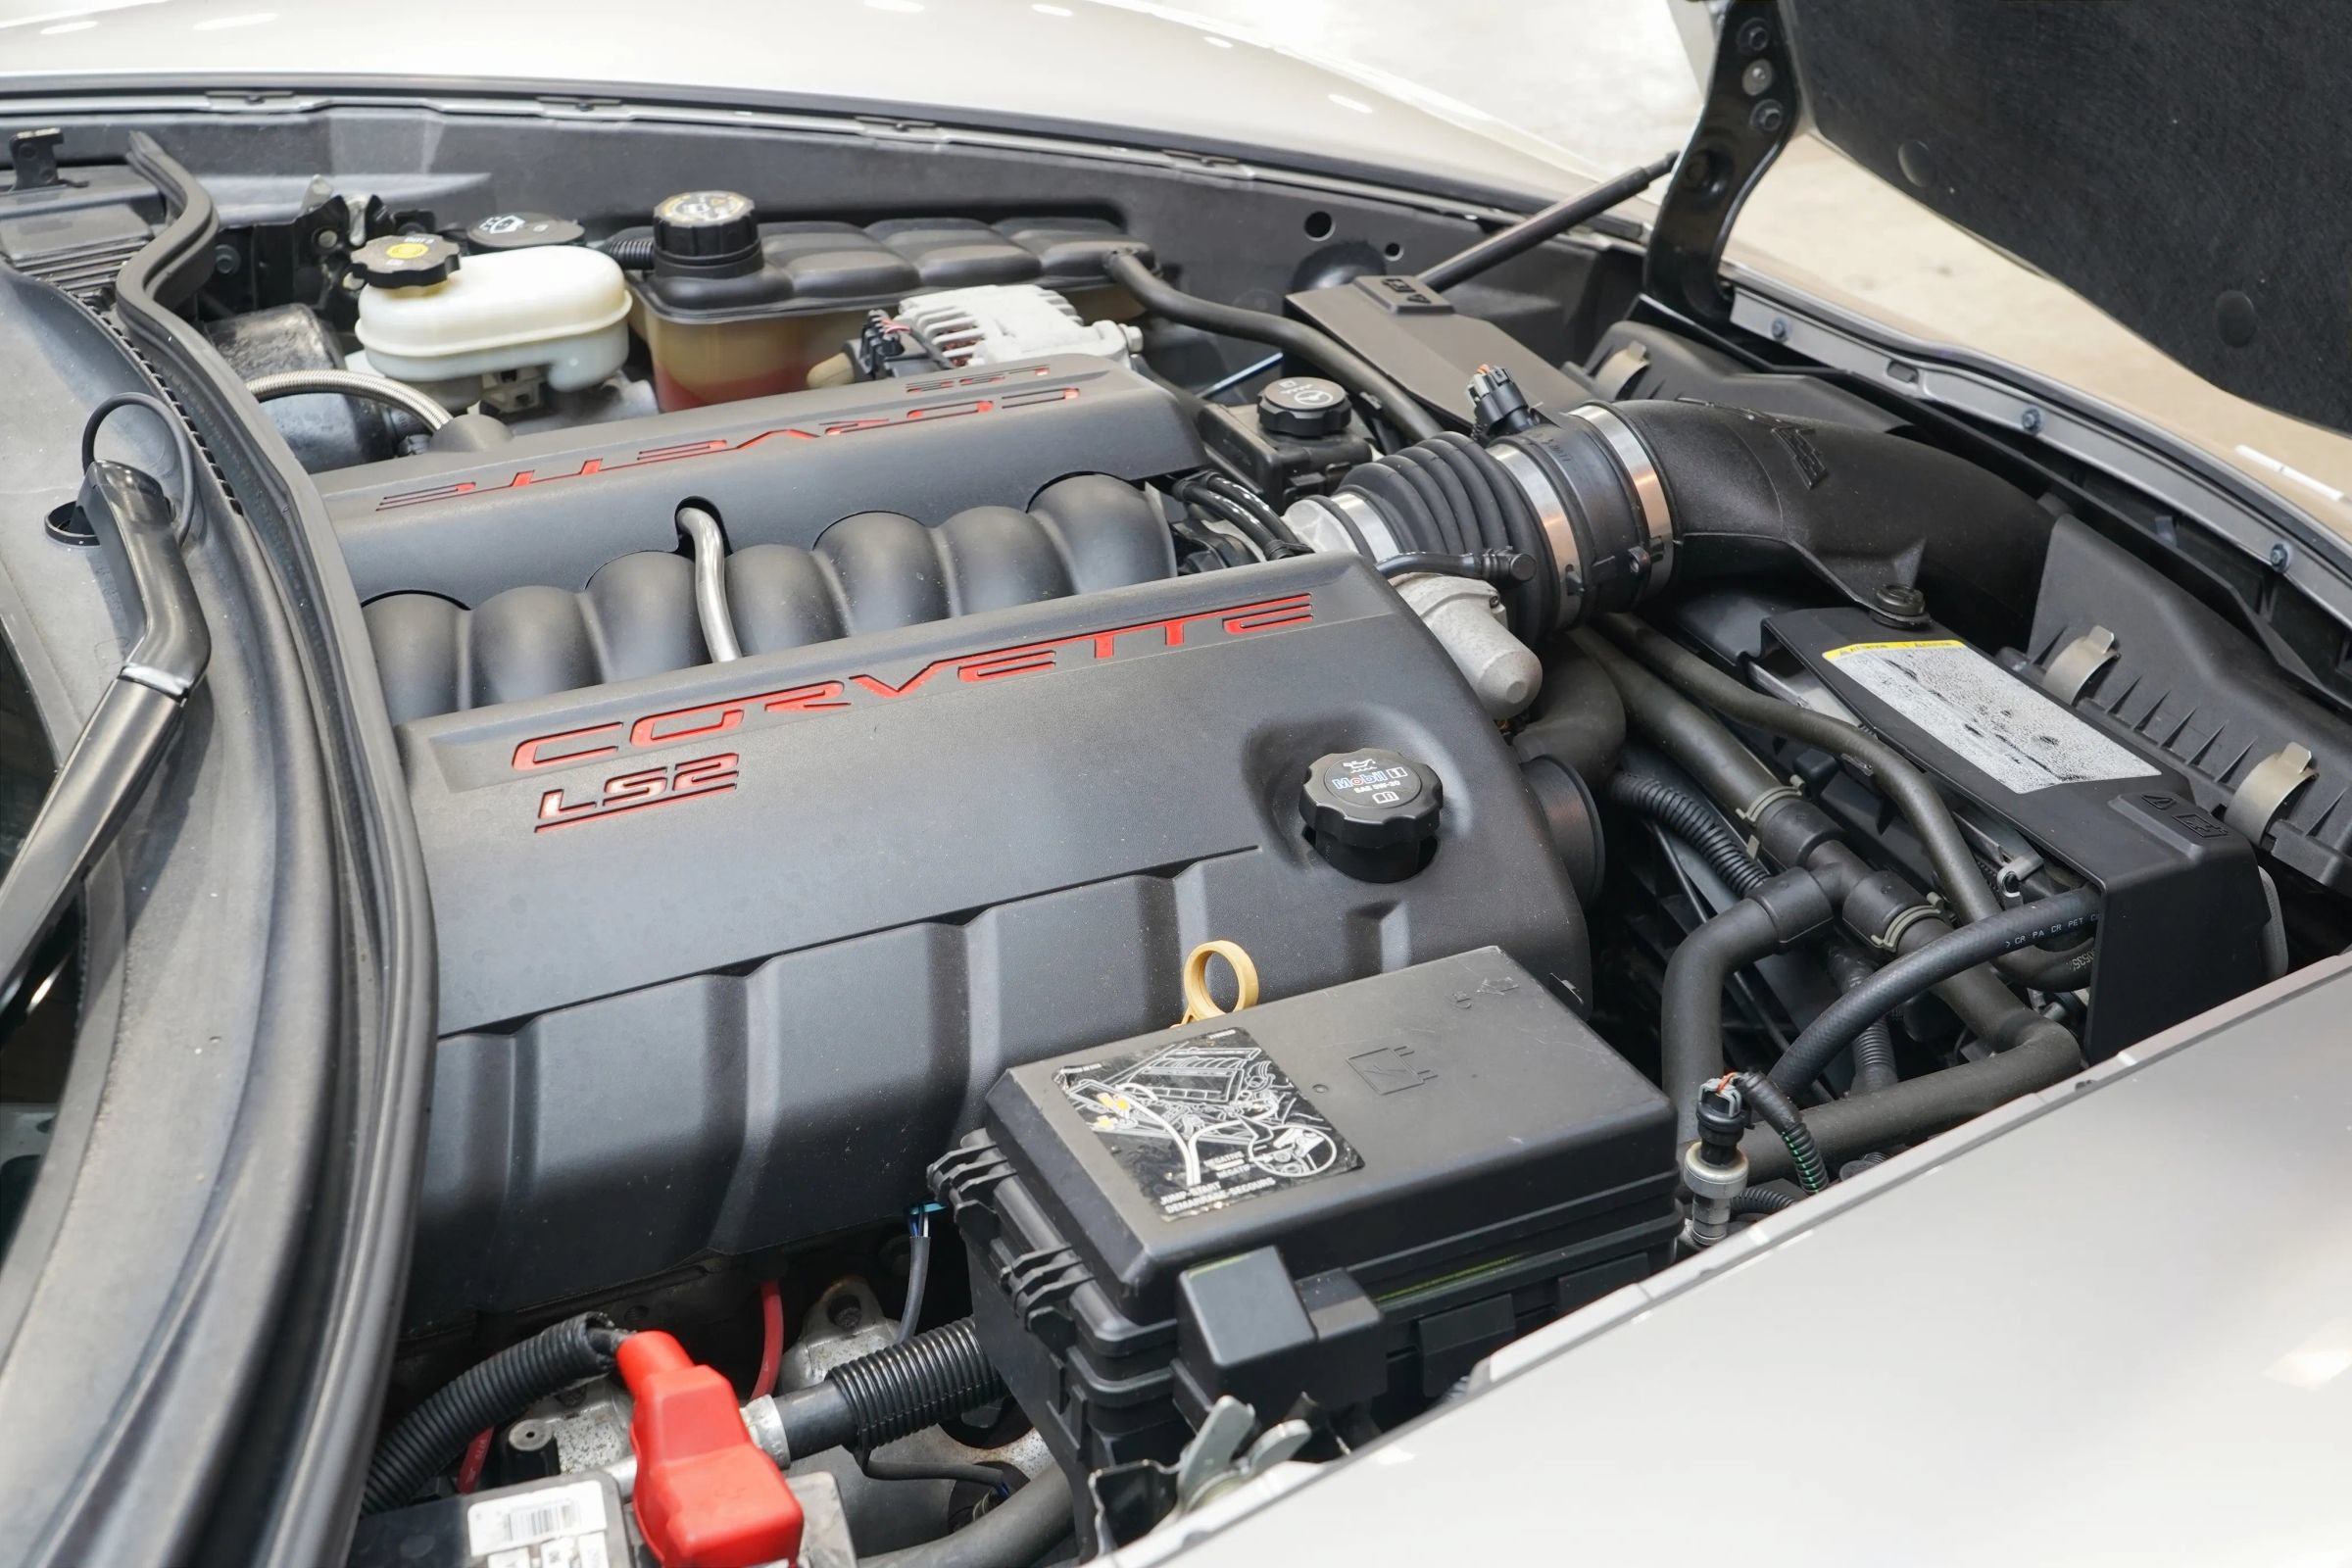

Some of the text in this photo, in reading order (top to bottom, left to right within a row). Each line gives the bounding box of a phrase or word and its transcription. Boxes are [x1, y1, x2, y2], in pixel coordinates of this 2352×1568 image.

[513, 593, 1313, 771] CORVETTE
[539, 752, 740, 820] LS2
[1332, 770, 1388, 789] Mobil
[2051, 924, 2062, 933] CR
[2068, 917, 2084, 928] PET
